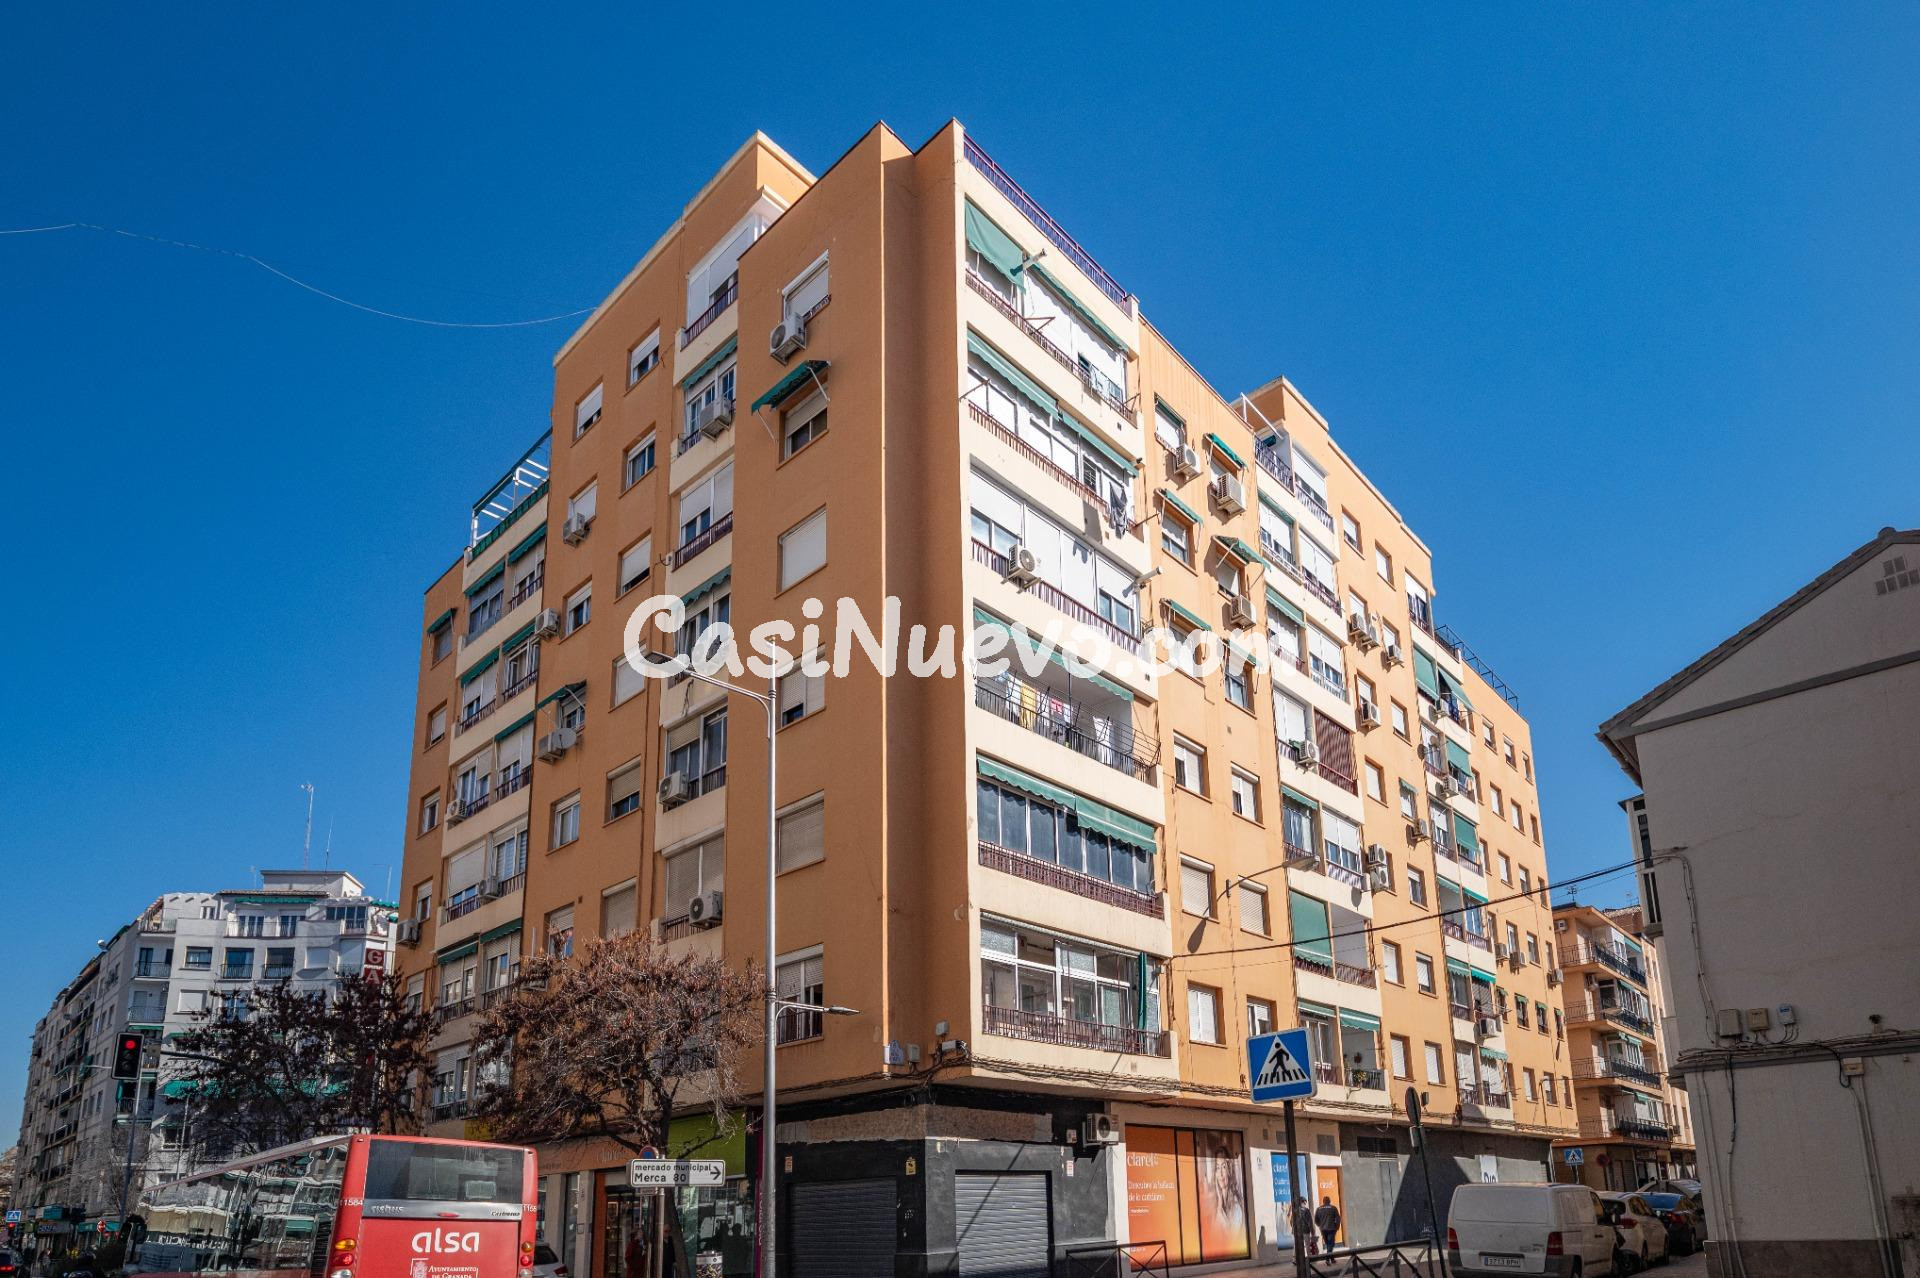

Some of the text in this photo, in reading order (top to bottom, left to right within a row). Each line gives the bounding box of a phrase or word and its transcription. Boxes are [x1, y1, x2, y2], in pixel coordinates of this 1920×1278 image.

[673, 1164, 711, 1172] municipal
[635, 1173, 666, 1182] Merca
[411, 1228, 480, 1253] alsa
